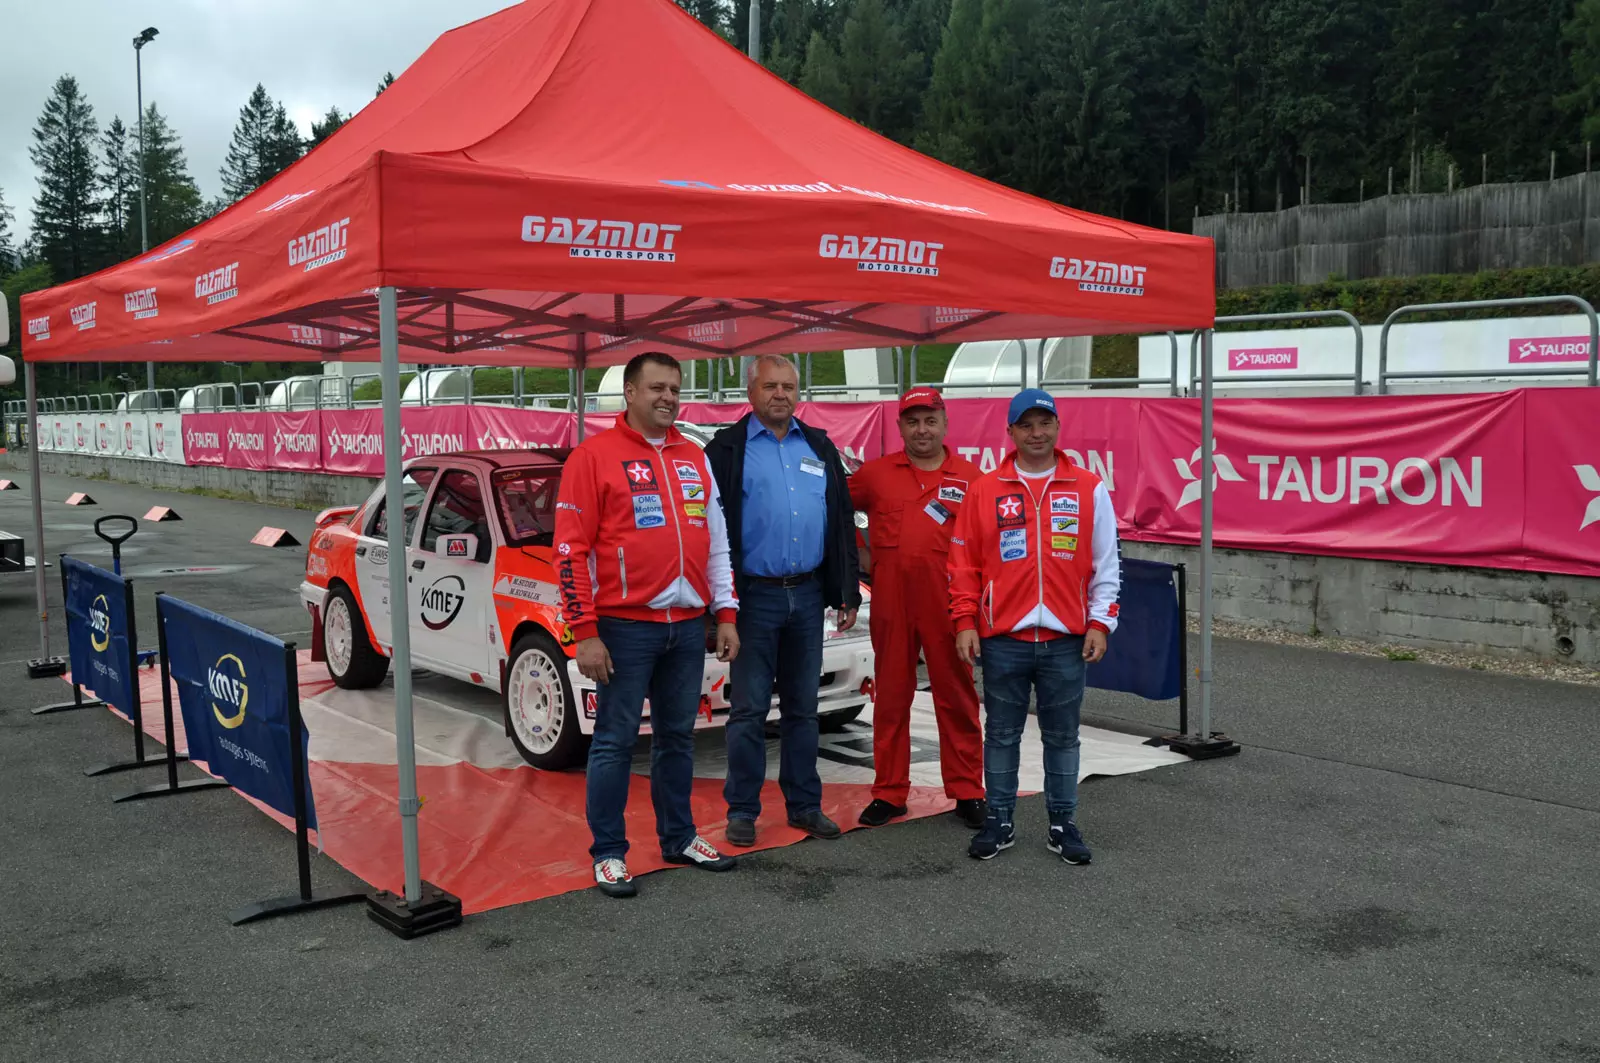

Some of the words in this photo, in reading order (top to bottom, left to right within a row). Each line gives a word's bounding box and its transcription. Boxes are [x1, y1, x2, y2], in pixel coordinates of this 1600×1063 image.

[288, 217, 350, 267] GAZMOT
[521, 215, 682, 250] GAZMOT
[570, 248, 675, 262] MOTORSPORT
[819, 233, 944, 266] GAZMOT
[304, 249, 347, 272] MOTORSPORT
[858, 262, 938, 275] MOTORSPORT
[195, 262, 239, 298] GAZMOT
[1049, 256, 1147, 287] GAZMOT
[207, 288, 238, 304] MOTORSPORT
[1079, 283, 1144, 296] MOTORSPORT
[124, 287, 158, 313] GAZMOT
[70, 301, 97, 325] GAZMOT
[1249, 353, 1291, 365] TAURON
[194, 432, 219, 449] TAURON
[235, 433, 264, 451] TAURON
[284, 433, 317, 452] TAURON
[341, 434, 382, 455] TAURON
[412, 433, 463, 456] TAURON
[957, 446, 1116, 492] TAON
[1247, 455, 1483, 508] TAURON
[638, 496, 657, 504] OMC
[941, 488, 965, 499] Marlbor
[635, 506, 661, 514] Motors
[1052, 499, 1078, 510] Marlboro
[1001, 539, 1025, 548] Motors
